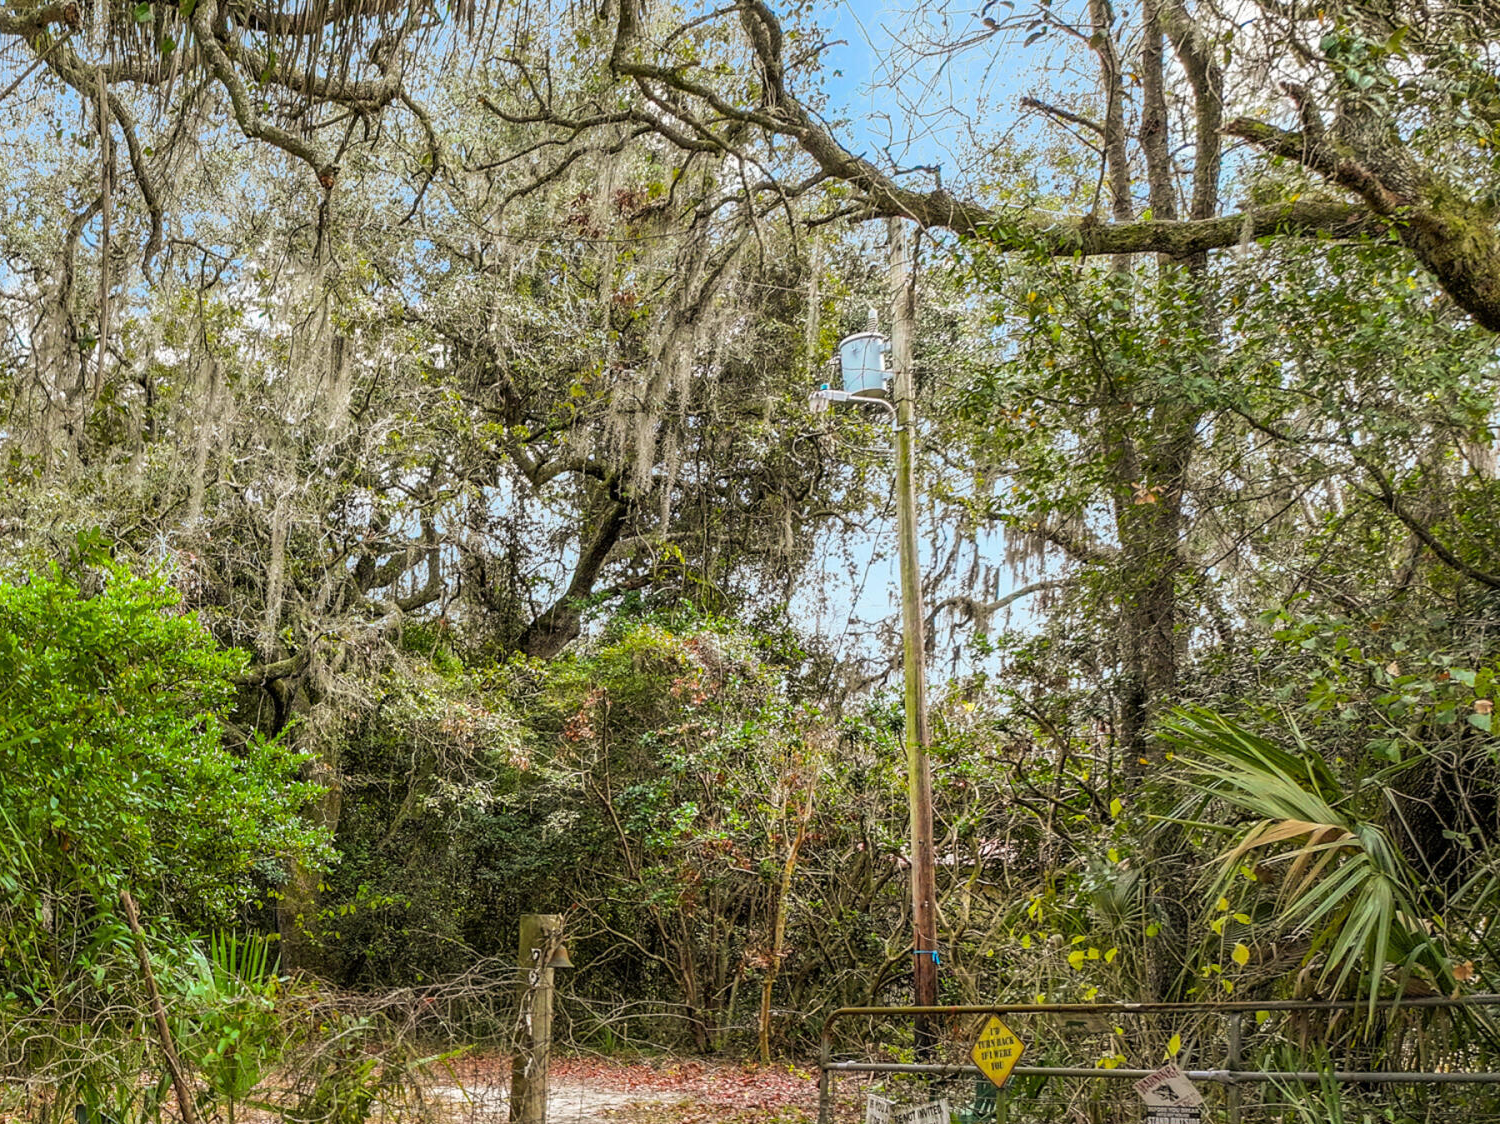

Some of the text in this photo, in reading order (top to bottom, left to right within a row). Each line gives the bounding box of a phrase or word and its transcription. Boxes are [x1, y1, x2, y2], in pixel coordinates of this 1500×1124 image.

[978, 1036, 1014, 1049] TURN BACK
[994, 1048, 1012, 1058] WERE
[991, 1061, 1003, 1070] YOU
[903, 1110, 916, 1122] NOT
